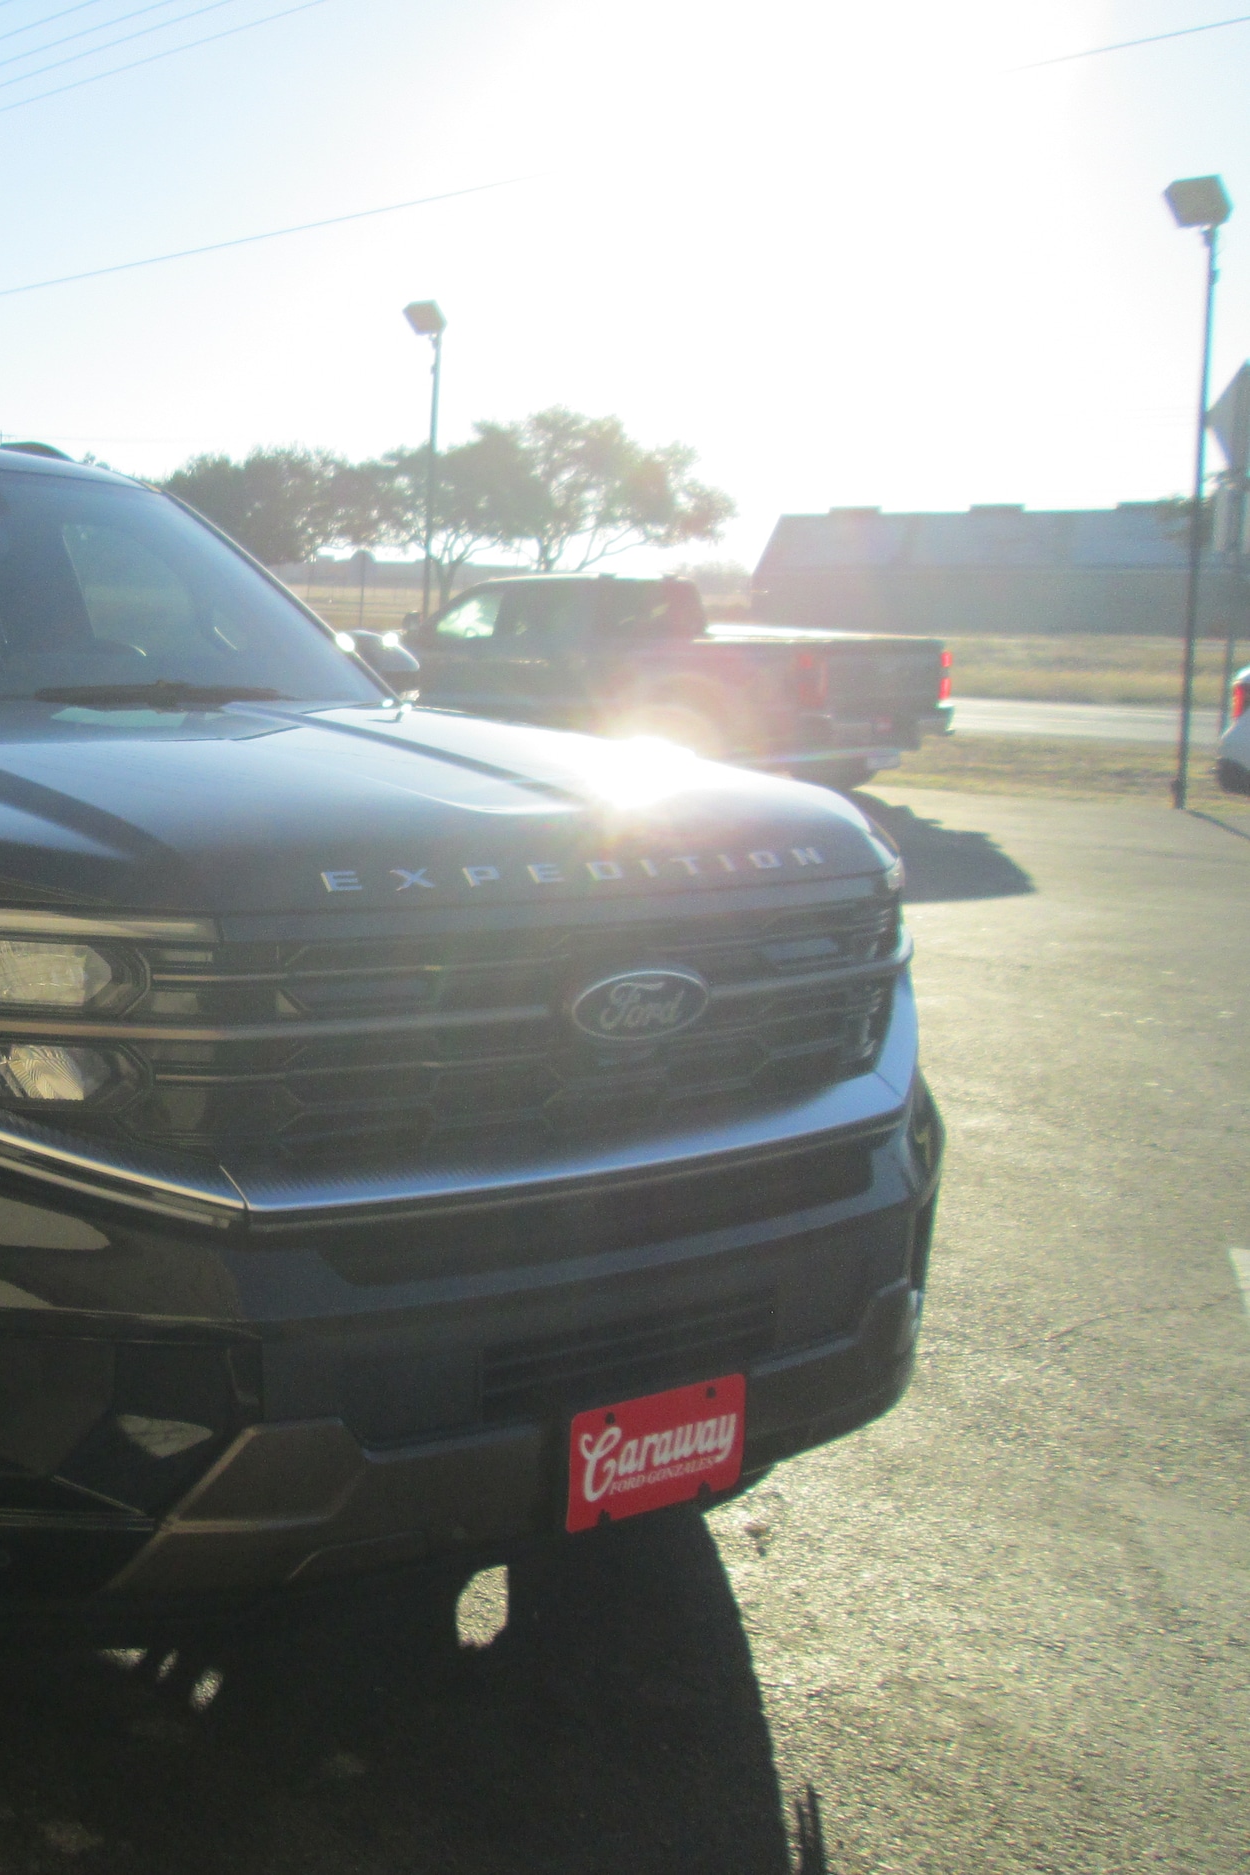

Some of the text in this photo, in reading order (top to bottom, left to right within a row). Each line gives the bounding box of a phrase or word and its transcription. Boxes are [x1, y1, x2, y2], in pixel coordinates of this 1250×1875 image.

[319, 847, 825, 892] EXPEDITION
[599, 981, 686, 1031] Ford
[579, 1413, 737, 1502] Caraway
